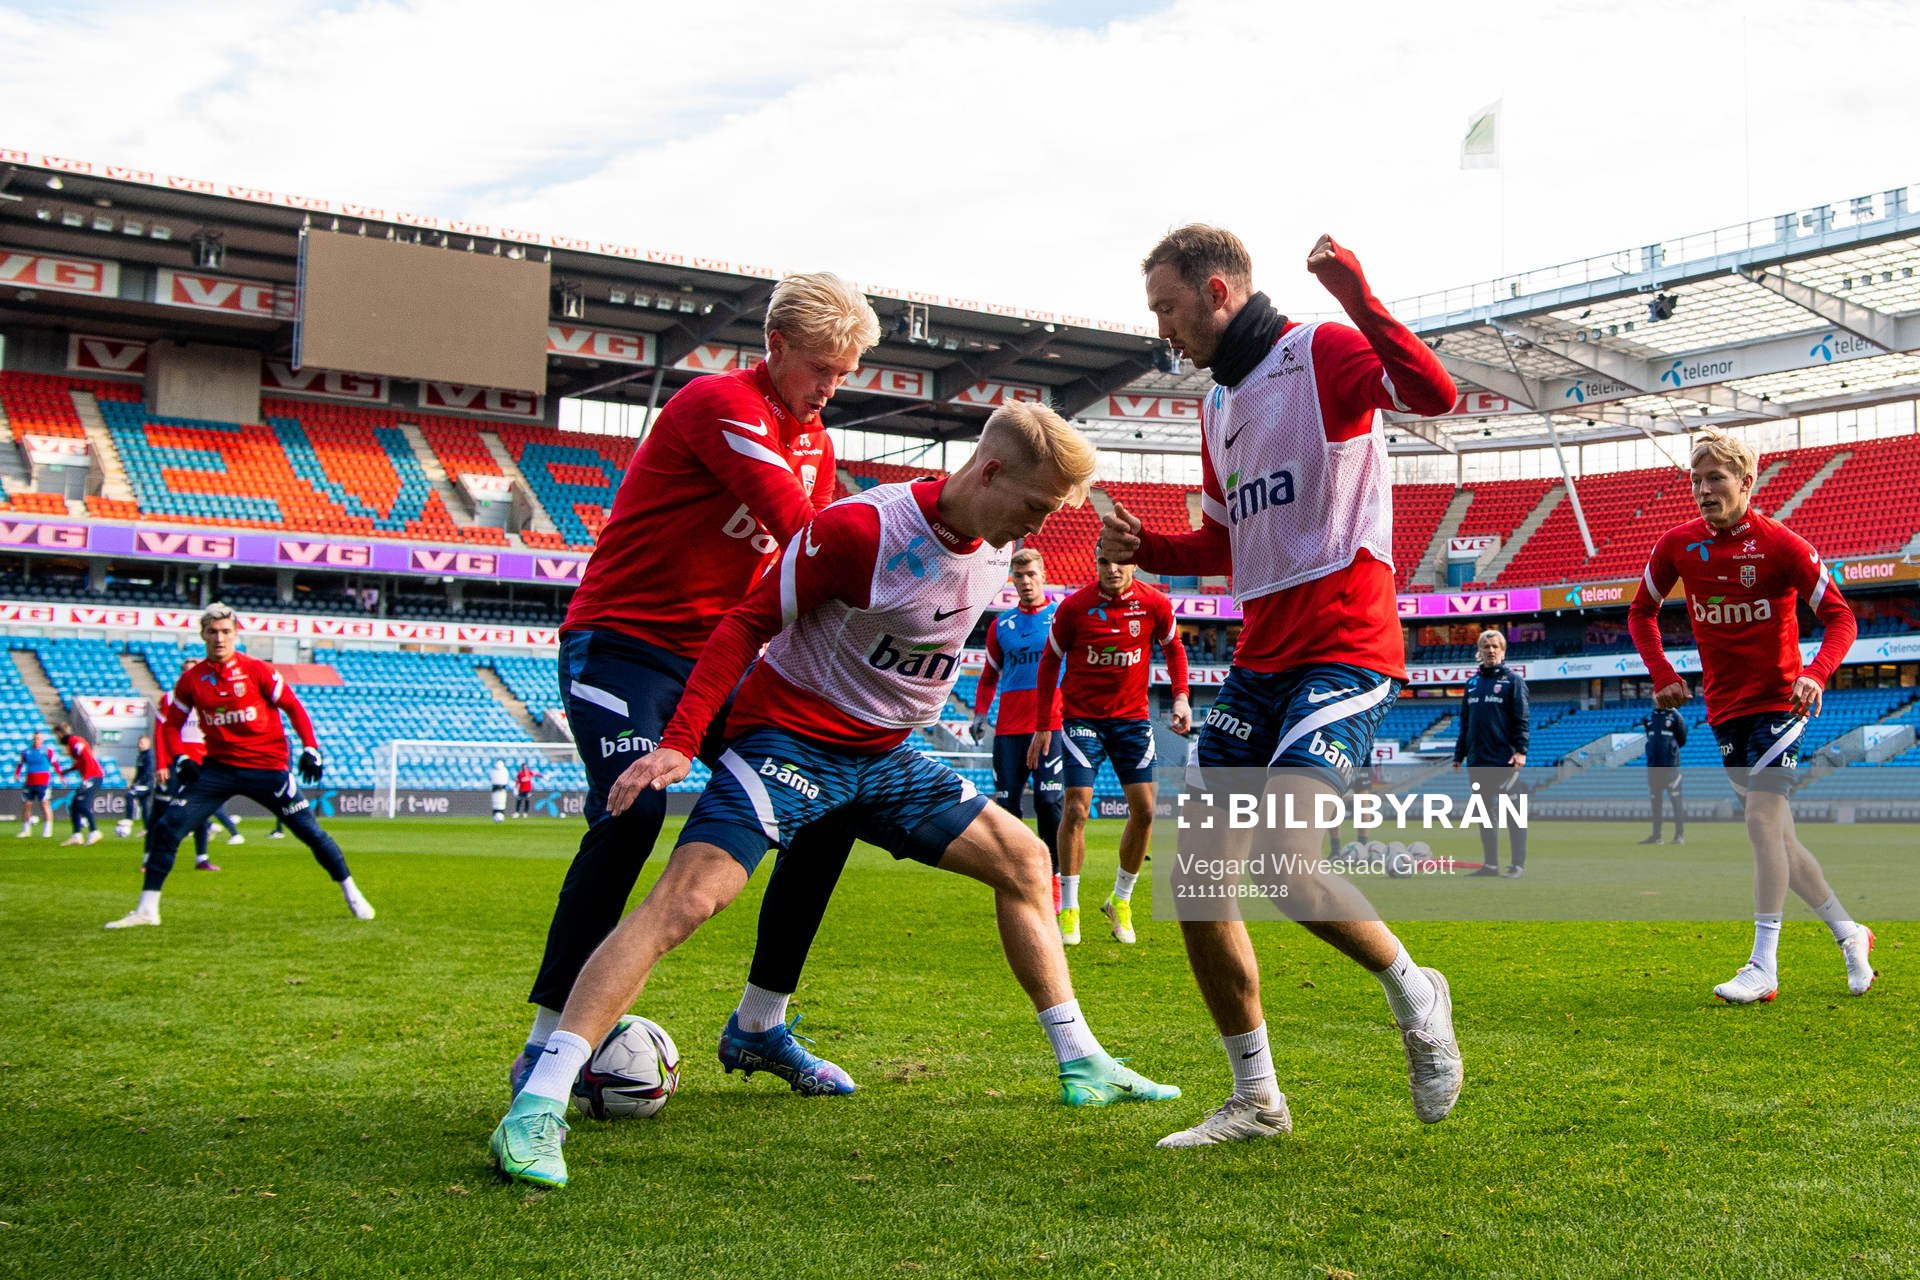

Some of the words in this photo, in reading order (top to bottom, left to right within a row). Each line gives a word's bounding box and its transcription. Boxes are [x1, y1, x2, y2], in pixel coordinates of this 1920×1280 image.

[42, 156, 91, 173] VG
[106, 166, 153, 183] VG
[168, 176, 214, 193] VG
[228, 185, 272, 202] VG
[286, 194, 329, 211] VG
[342, 203, 384, 220] VG
[397, 211, 438, 228] VG
[450, 220, 489, 237] VG
[501, 228, 540, 244] VG
[552, 235, 589, 251] VG
[0, 254, 97, 291] VG
[178, 277, 296, 312] VG
[548, 327, 641, 360] VG
[1835, 335, 1874, 355] telen
[82, 340, 147, 369] V
[266, 363, 380, 396] VG
[1684, 360, 1734, 380] telenor
[848, 368, 919, 394] VG
[428, 384, 533, 414] VG
[1121, 396, 1199, 420] VG
[1227, 470, 1295, 526] ama
[0, 524, 86, 548] VG
[722, 503, 780, 555] ba
[138, 532, 233, 558] VG
[279, 541, 368, 565] VG
[412, 551, 495, 573] VG
[537, 559, 585, 580] V
[1844, 562, 1896, 580] telenor
[1450, 593, 1507, 612] VG
[1582, 587, 1624, 602] telenor
[71, 609, 139, 625] VG
[1692, 594, 1771, 625] bama
[238, 617, 298, 633] VG
[313, 620, 372, 636] VG
[386, 624, 444, 640] VG
[458, 627, 513, 643] VG
[869, 634, 961, 681] bam
[1007, 648, 1043, 666] bam
[1087, 645, 1142, 667] bama
[203, 706, 257, 726] bama
[1206, 707, 1253, 741] ama
[601, 735, 659, 758] bam
[1308, 731, 1354, 776] bam
[759, 757, 820, 800] bama
[408, 795, 449, 813] t-we
